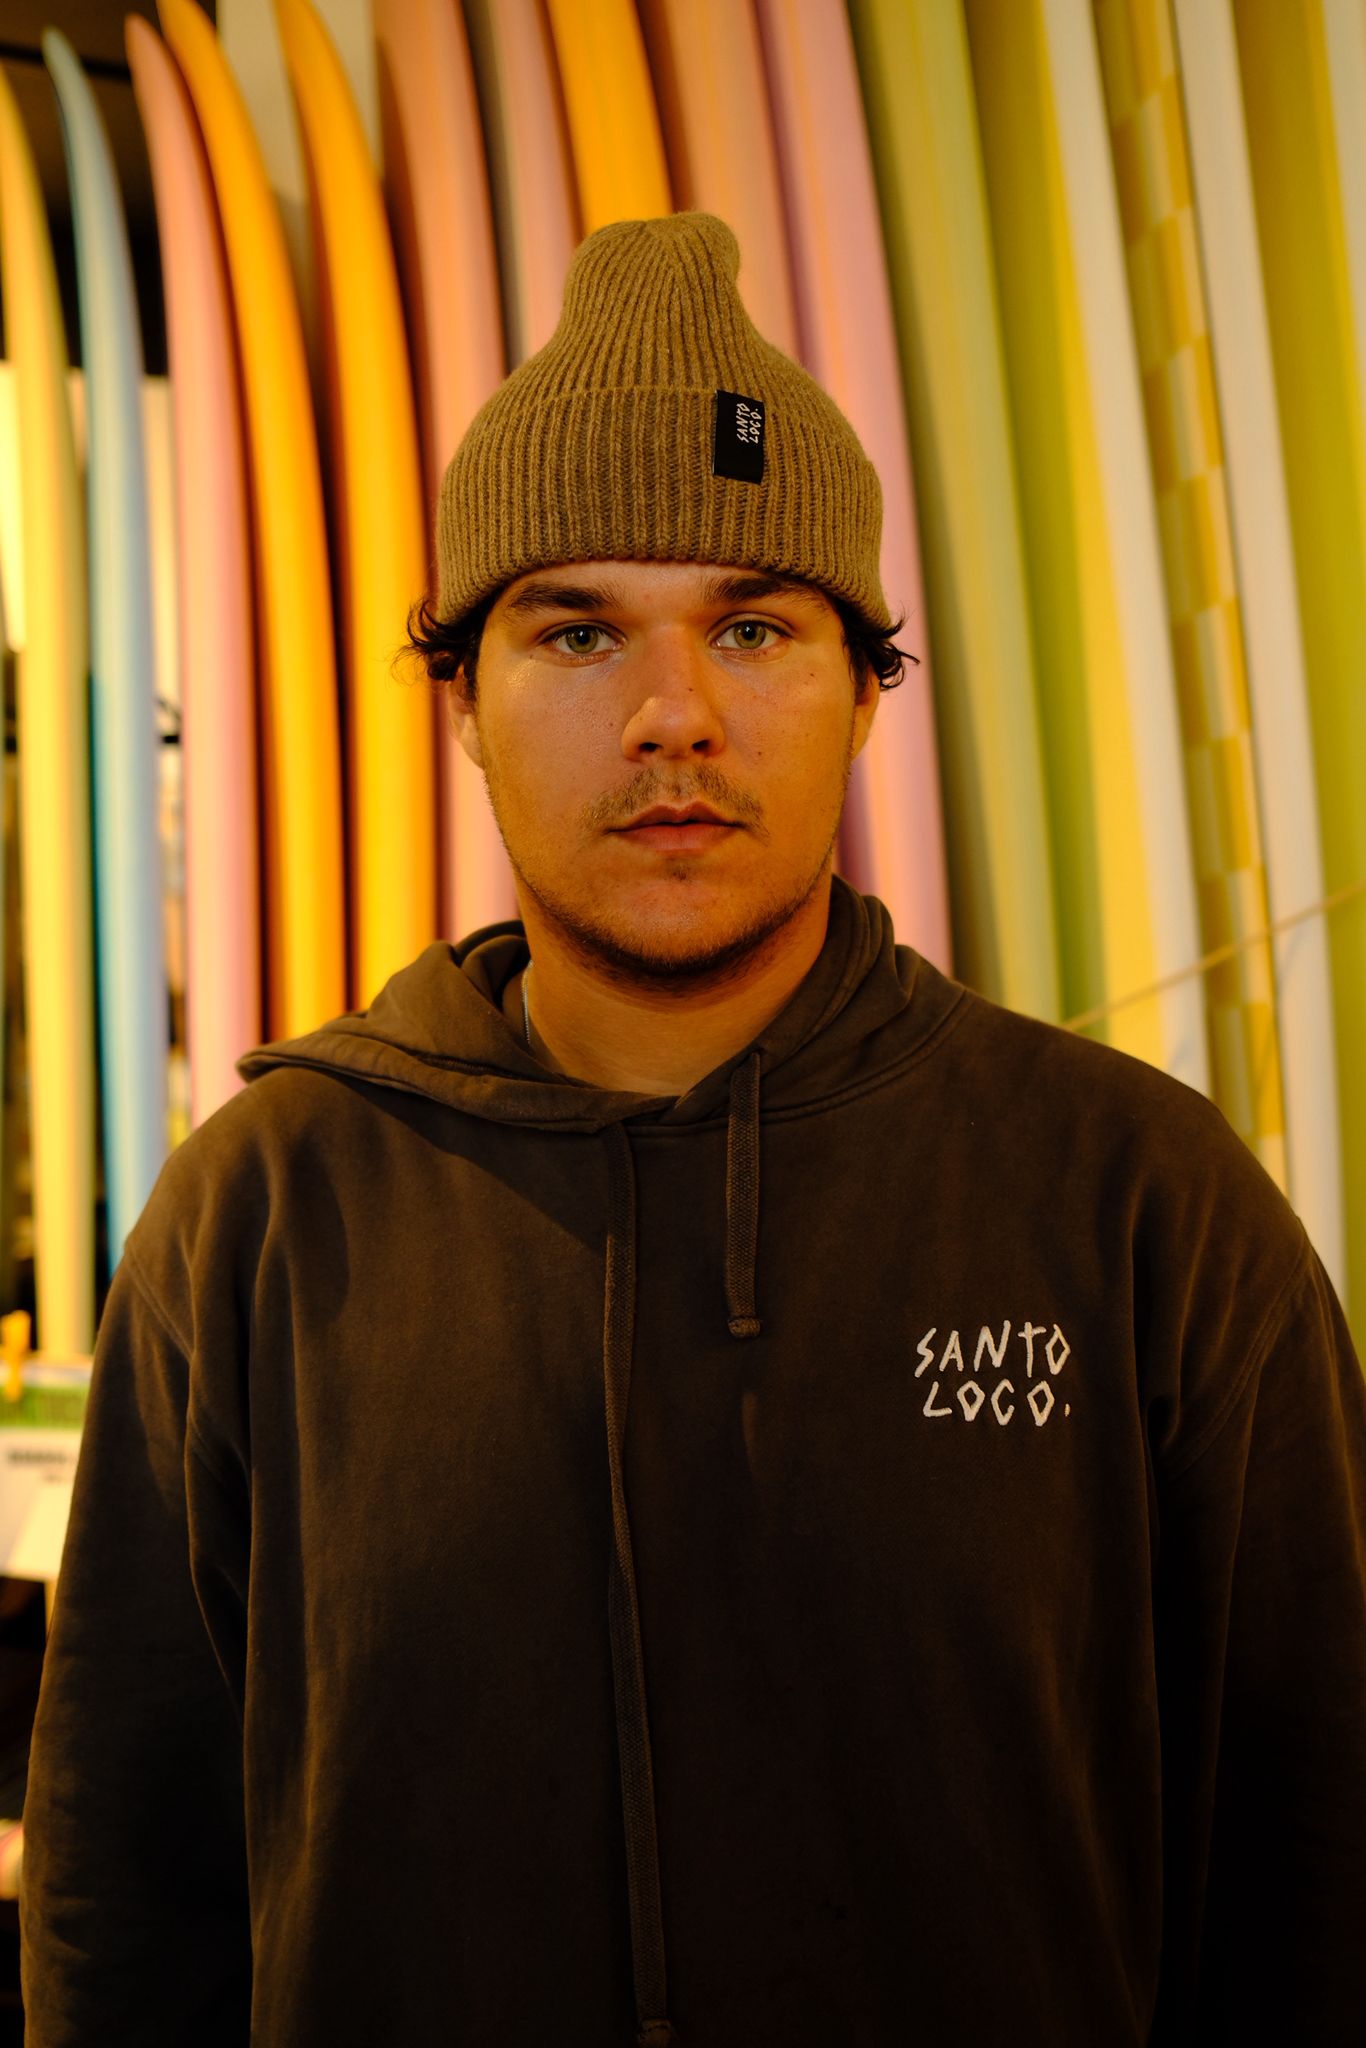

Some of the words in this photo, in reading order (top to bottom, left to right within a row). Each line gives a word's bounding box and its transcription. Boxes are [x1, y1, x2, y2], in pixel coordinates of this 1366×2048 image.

[736, 402, 750, 443] SANTO
[914, 1319, 1072, 1378] SANTO
[923, 1378, 1072, 1427] LOCO.
